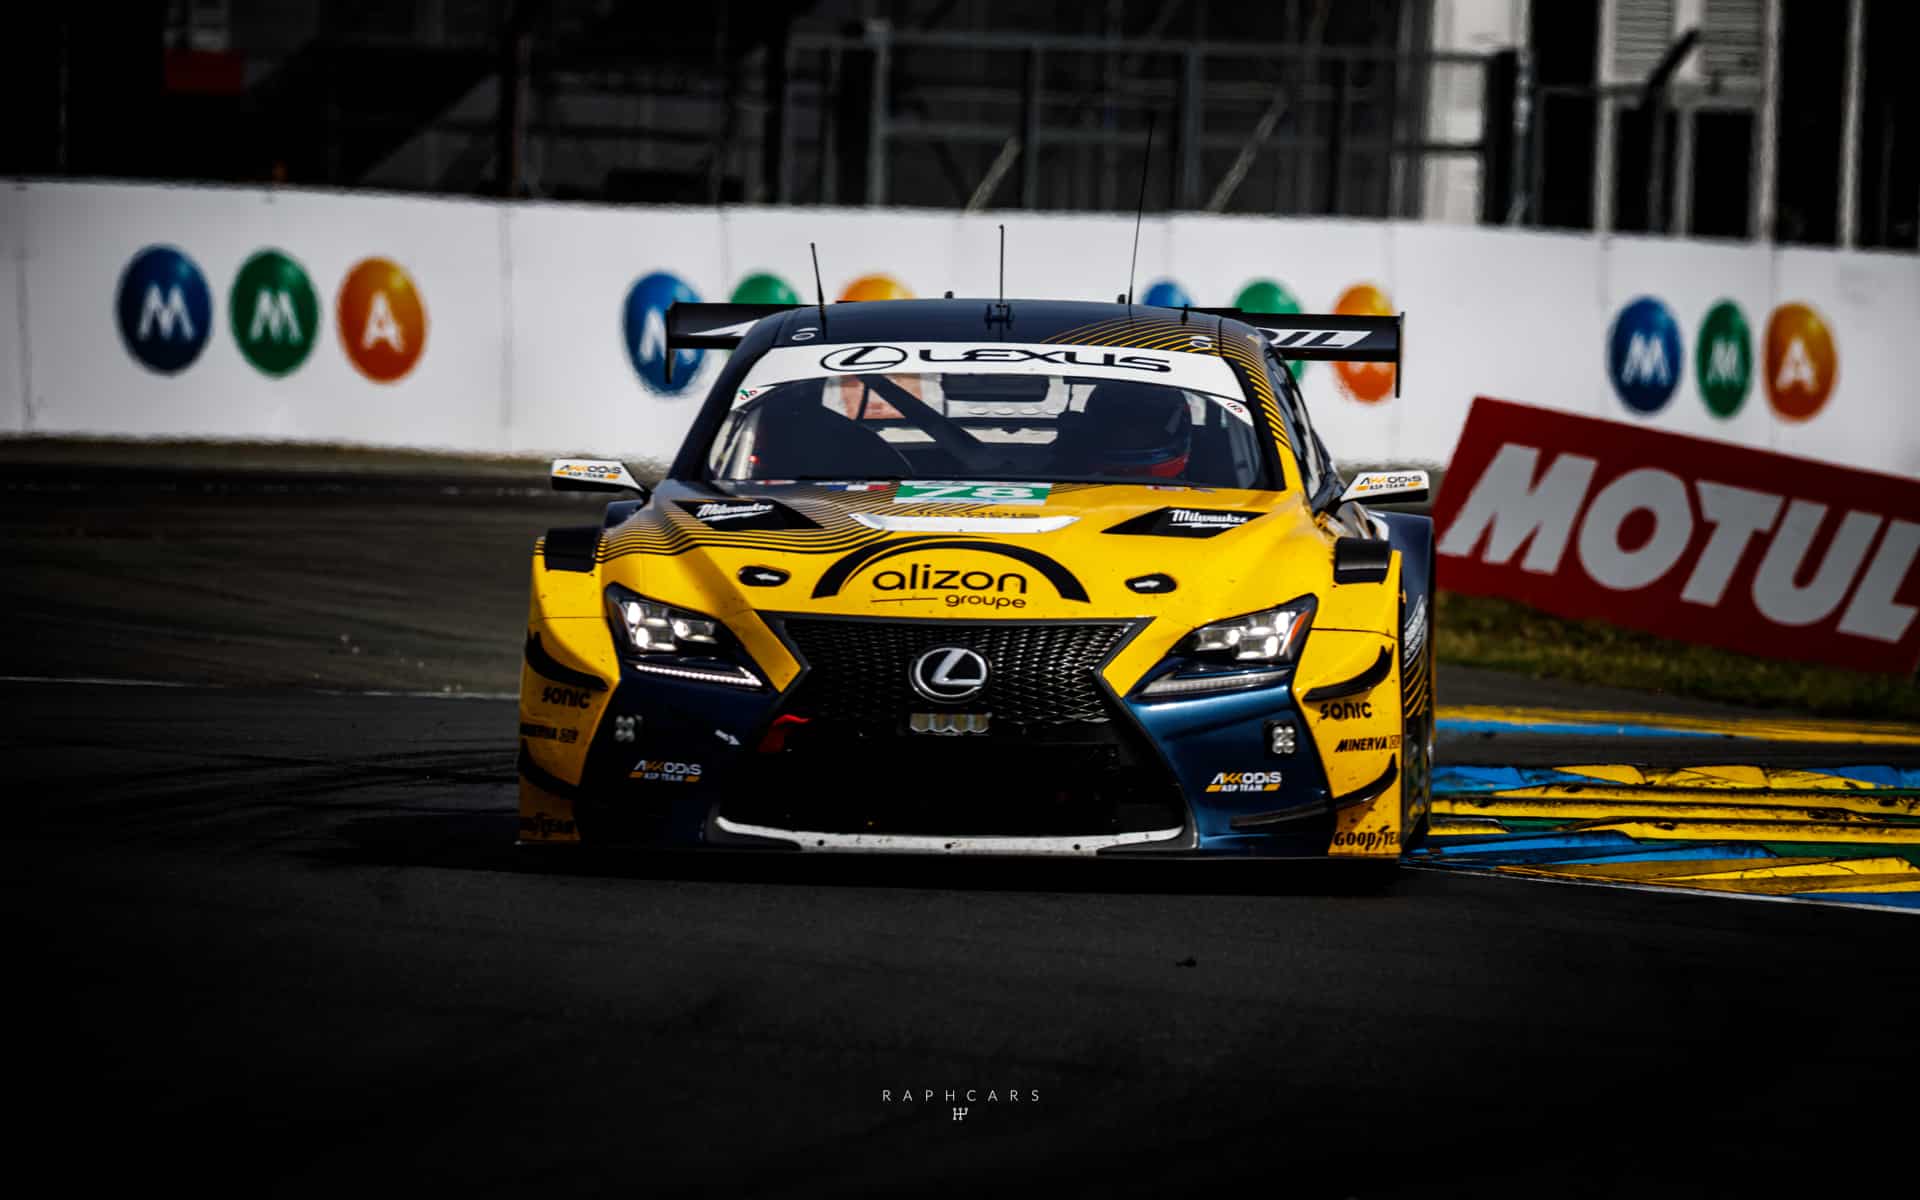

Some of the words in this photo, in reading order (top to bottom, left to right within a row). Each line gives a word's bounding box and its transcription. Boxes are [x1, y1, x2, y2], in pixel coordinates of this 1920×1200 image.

[919, 349, 1171, 373] LEXUS
[912, 486, 1035, 499] 78
[1437, 440, 1920, 646] MOTUL
[873, 563, 1027, 594] alizon
[945, 594, 1027, 609] groupe
[1334, 736, 1388, 752] MINERVA
